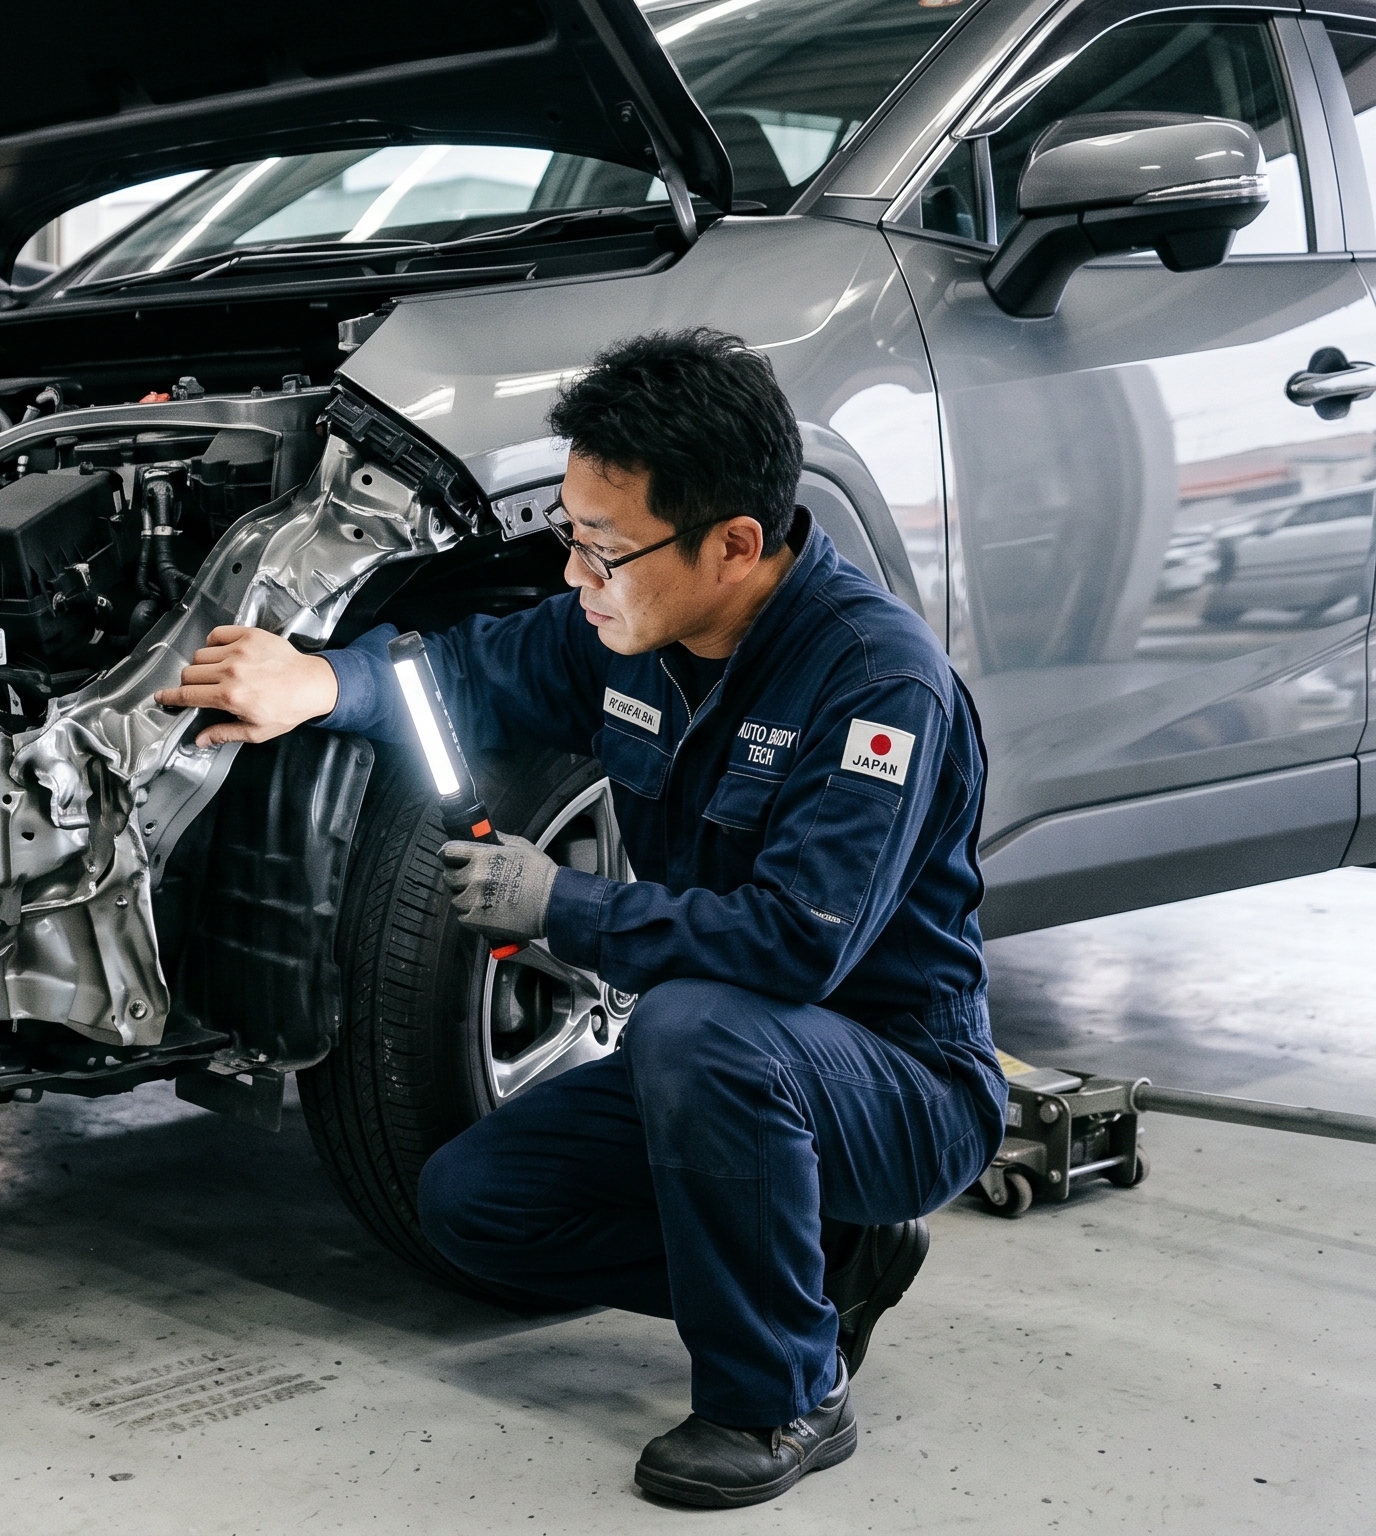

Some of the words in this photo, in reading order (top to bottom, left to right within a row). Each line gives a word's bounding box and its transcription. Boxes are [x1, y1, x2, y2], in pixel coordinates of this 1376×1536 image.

[737, 721, 767, 743] AUTO
[766, 727, 797, 748] BODY
[747, 744, 775, 766] TECH
[852, 754, 898, 776] JAPAN
